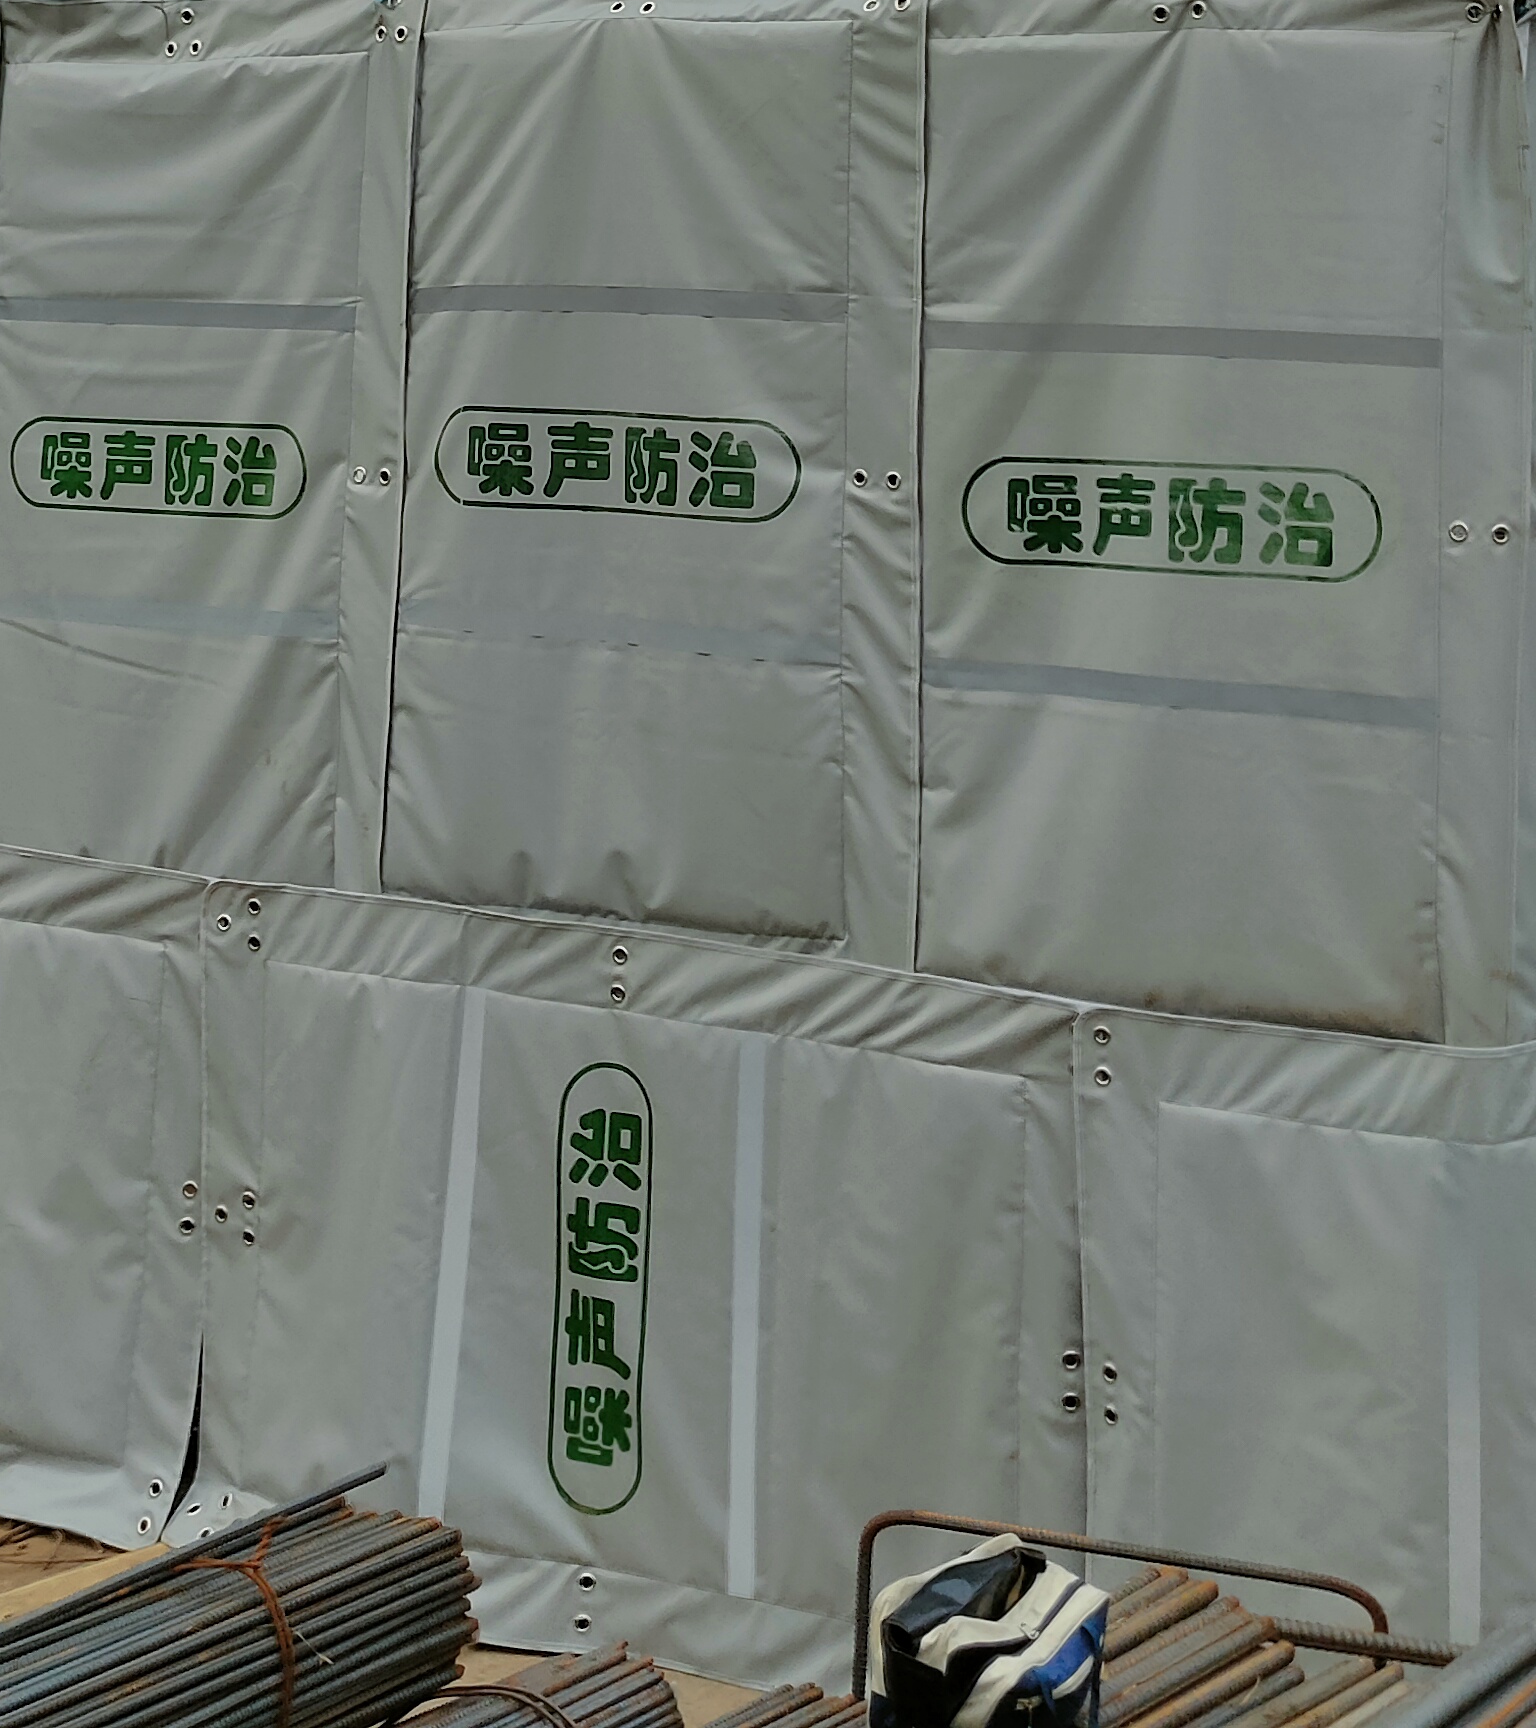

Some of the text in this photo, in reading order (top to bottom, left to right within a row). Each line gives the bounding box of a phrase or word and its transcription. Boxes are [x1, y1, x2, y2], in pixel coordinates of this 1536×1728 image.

[40, 432, 277, 507] 噪声防治
[467, 421, 757, 510] 噪声防治
[1007, 472, 1335, 568] 噪声防治
[564, 1108, 642, 1468] 噪声防治
